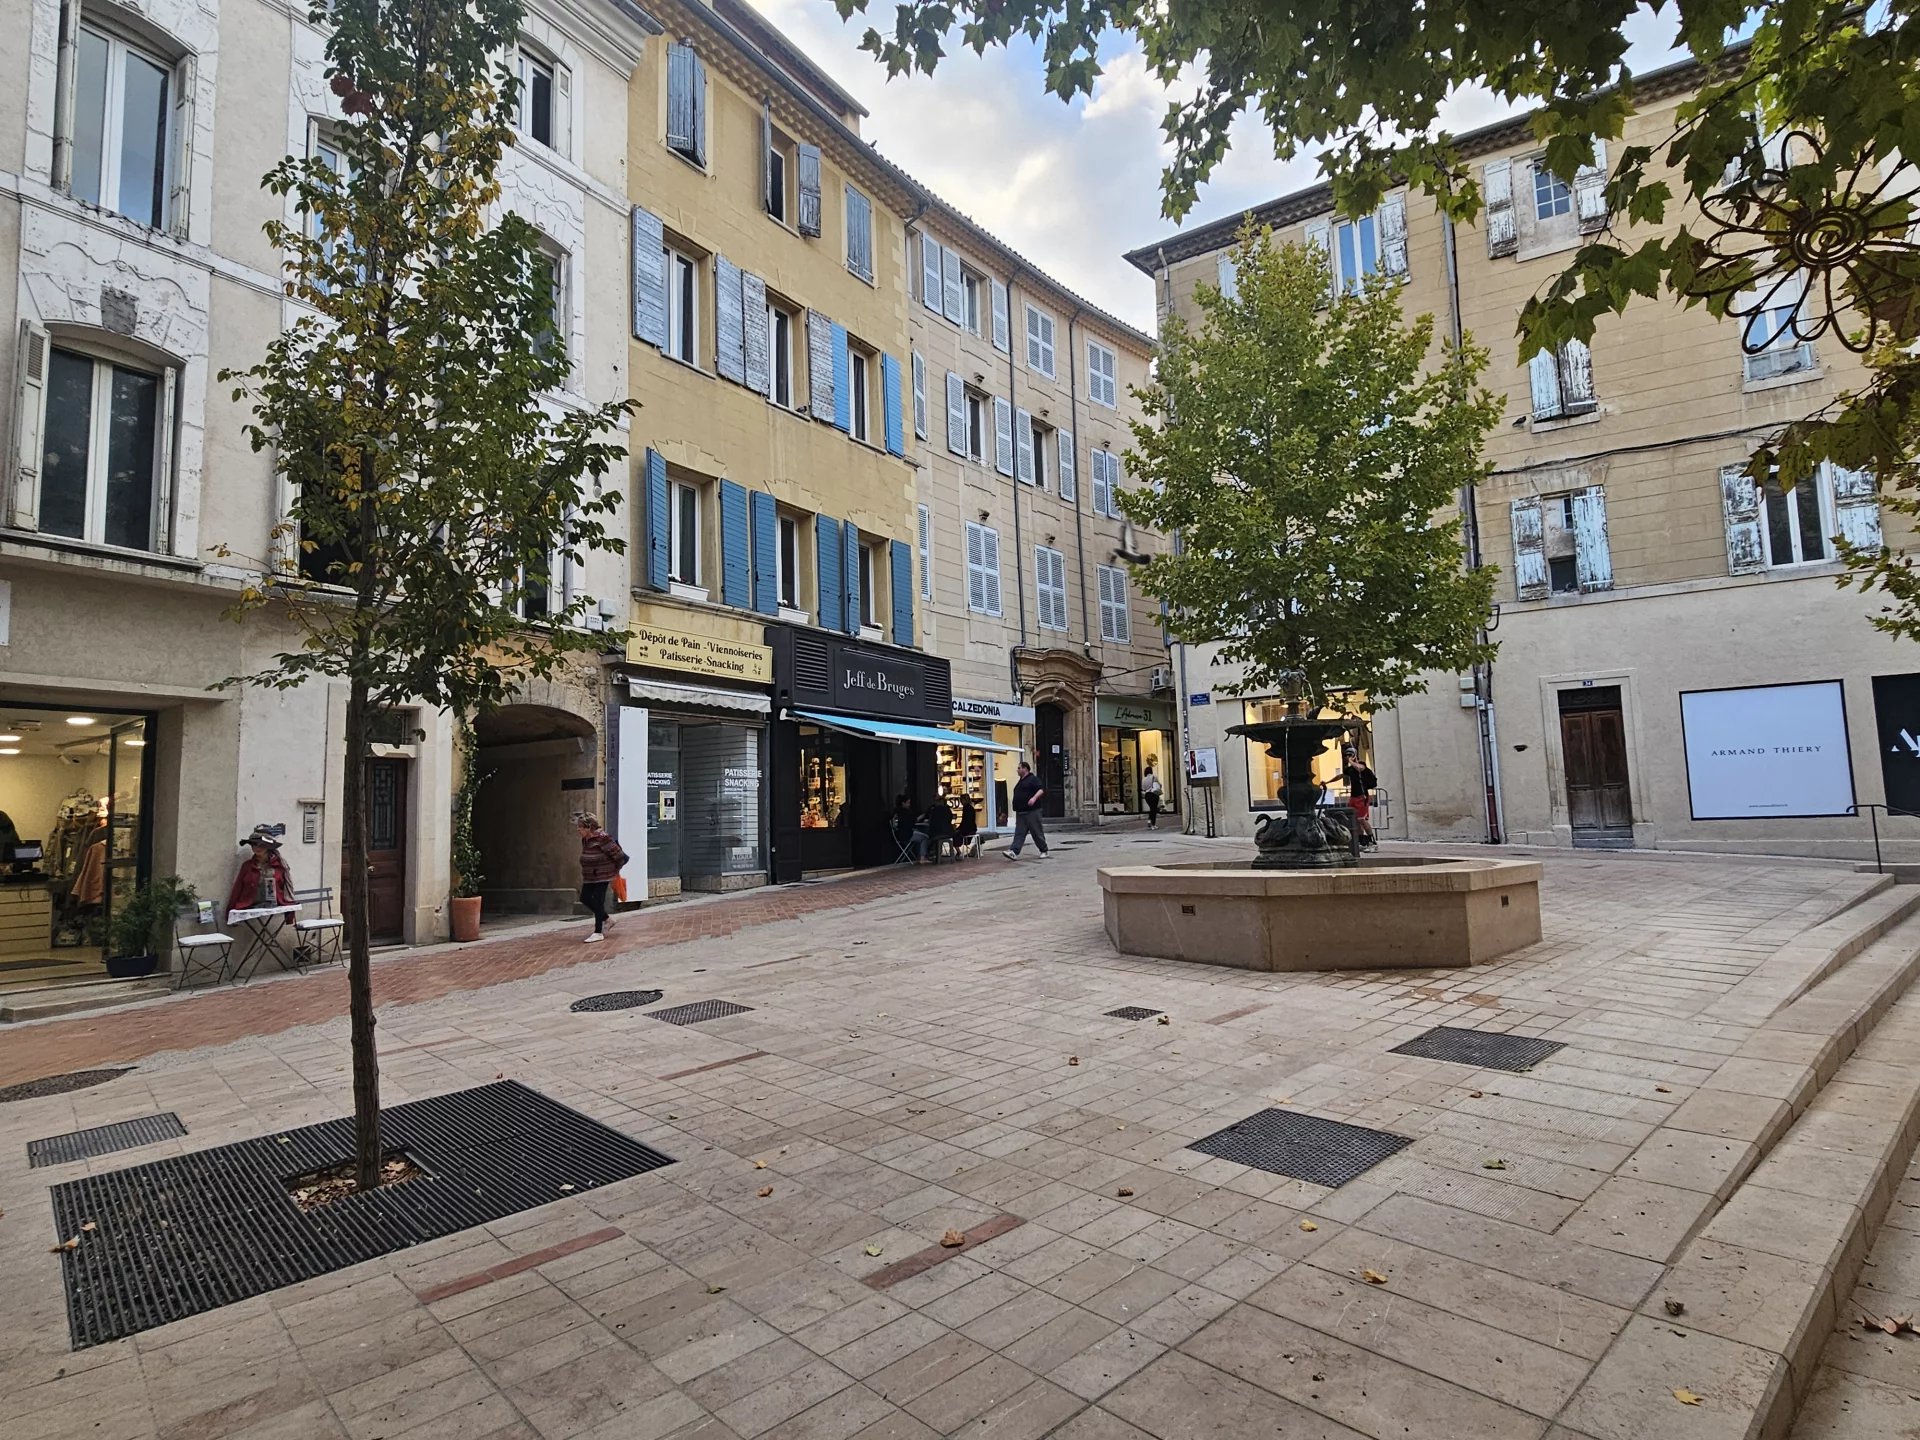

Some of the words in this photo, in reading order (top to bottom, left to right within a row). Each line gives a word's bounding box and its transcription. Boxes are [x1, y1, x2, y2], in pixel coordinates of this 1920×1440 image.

[668, 636, 679, 646] de
[681, 637, 701, 650] Pain
[843, 669, 866, 689] Jeff
[866, 677, 876, 690] de
[877, 671, 915, 700] Bruges
[952, 700, 1001, 717] CALZEDONIA
[1711, 747, 1765, 757] ARMAND
[1773, 745, 1822, 754] THIERY
[724, 768, 762, 778] PATISSERIE
[724, 778, 760, 788] SNACKING
